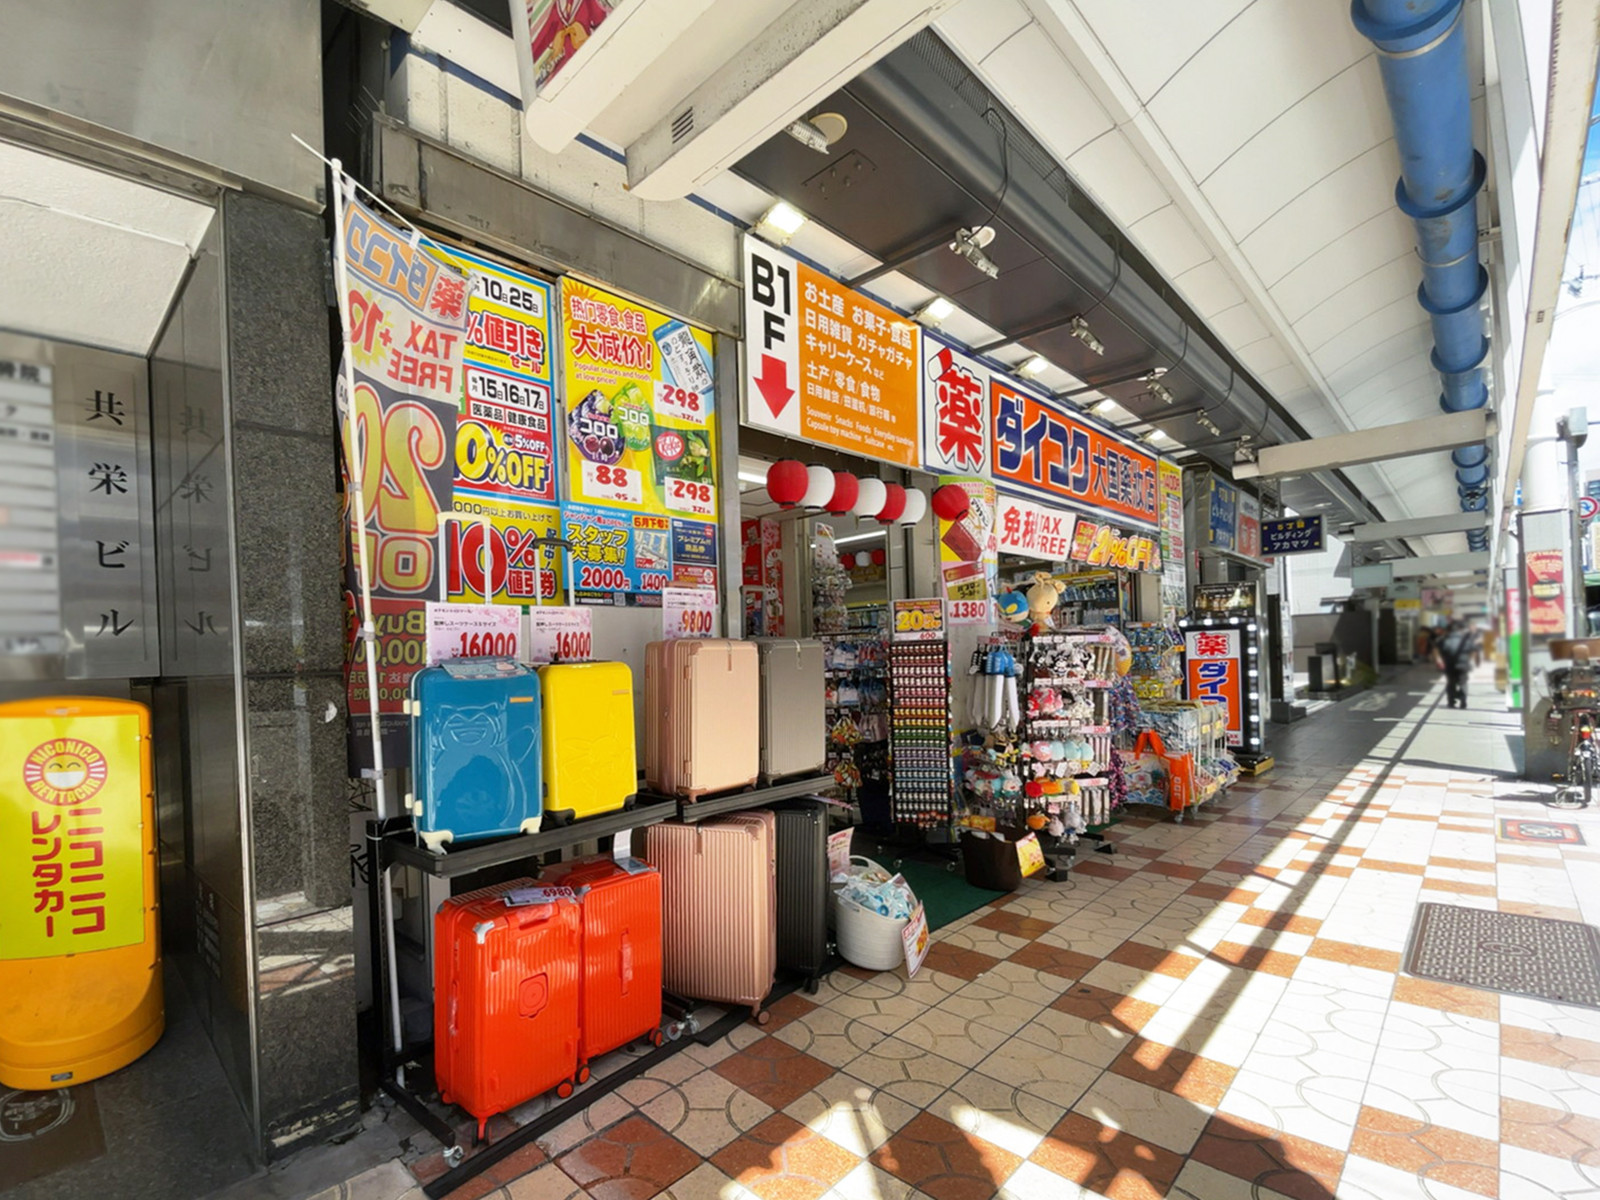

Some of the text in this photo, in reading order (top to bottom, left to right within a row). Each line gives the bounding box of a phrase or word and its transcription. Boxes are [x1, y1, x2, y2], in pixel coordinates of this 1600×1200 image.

[751, 252, 791, 317] B1
[804, 281, 845, 318] お土産
[763, 310, 785, 350] F
[805, 308, 913, 371] 日用雑貨 ガチャガチャ
[510, 355, 542, 374] セール
[805, 332, 873, 375] キャリーケース
[574, 361, 600, 372] Popular
[600, 366, 621, 377] snacks
[622, 370, 634, 379] and
[583, 373, 596, 382] low
[663, 383, 700, 412] 298
[937, 348, 985, 469] 薬
[472, 402, 504, 421] 医薬品
[507, 410, 547, 431] 健康食品
[579, 417, 618, 439] コロロ
[617, 406, 650, 426] コロロ
[806, 405, 832, 421] Souvenir
[835, 414, 853, 428] Snacks
[873, 427, 895, 442] Everyday
[806, 417, 829, 432] Capsule
[840, 429, 862, 442] machine
[514, 434, 546, 452] 5%OFF
[995, 393, 1090, 496] ダイコク
[595, 464, 629, 488] 88
[673, 479, 711, 503] 298
[85, 390, 135, 637] 共栄ビル
[567, 523, 628, 546] スタッフ
[449, 521, 536, 596] 10%
[681, 609, 713, 633] 9800
[459, 631, 517, 658] 16000
[556, 631, 591, 659] 16000
[1196, 632, 1229, 656] 薬
[31, 740, 101, 765] NICONICO
[30, 778, 101, 803] RENTACAR
[31, 810, 64, 938] レンタカー
[68, 806, 106, 936] ニコニコ
